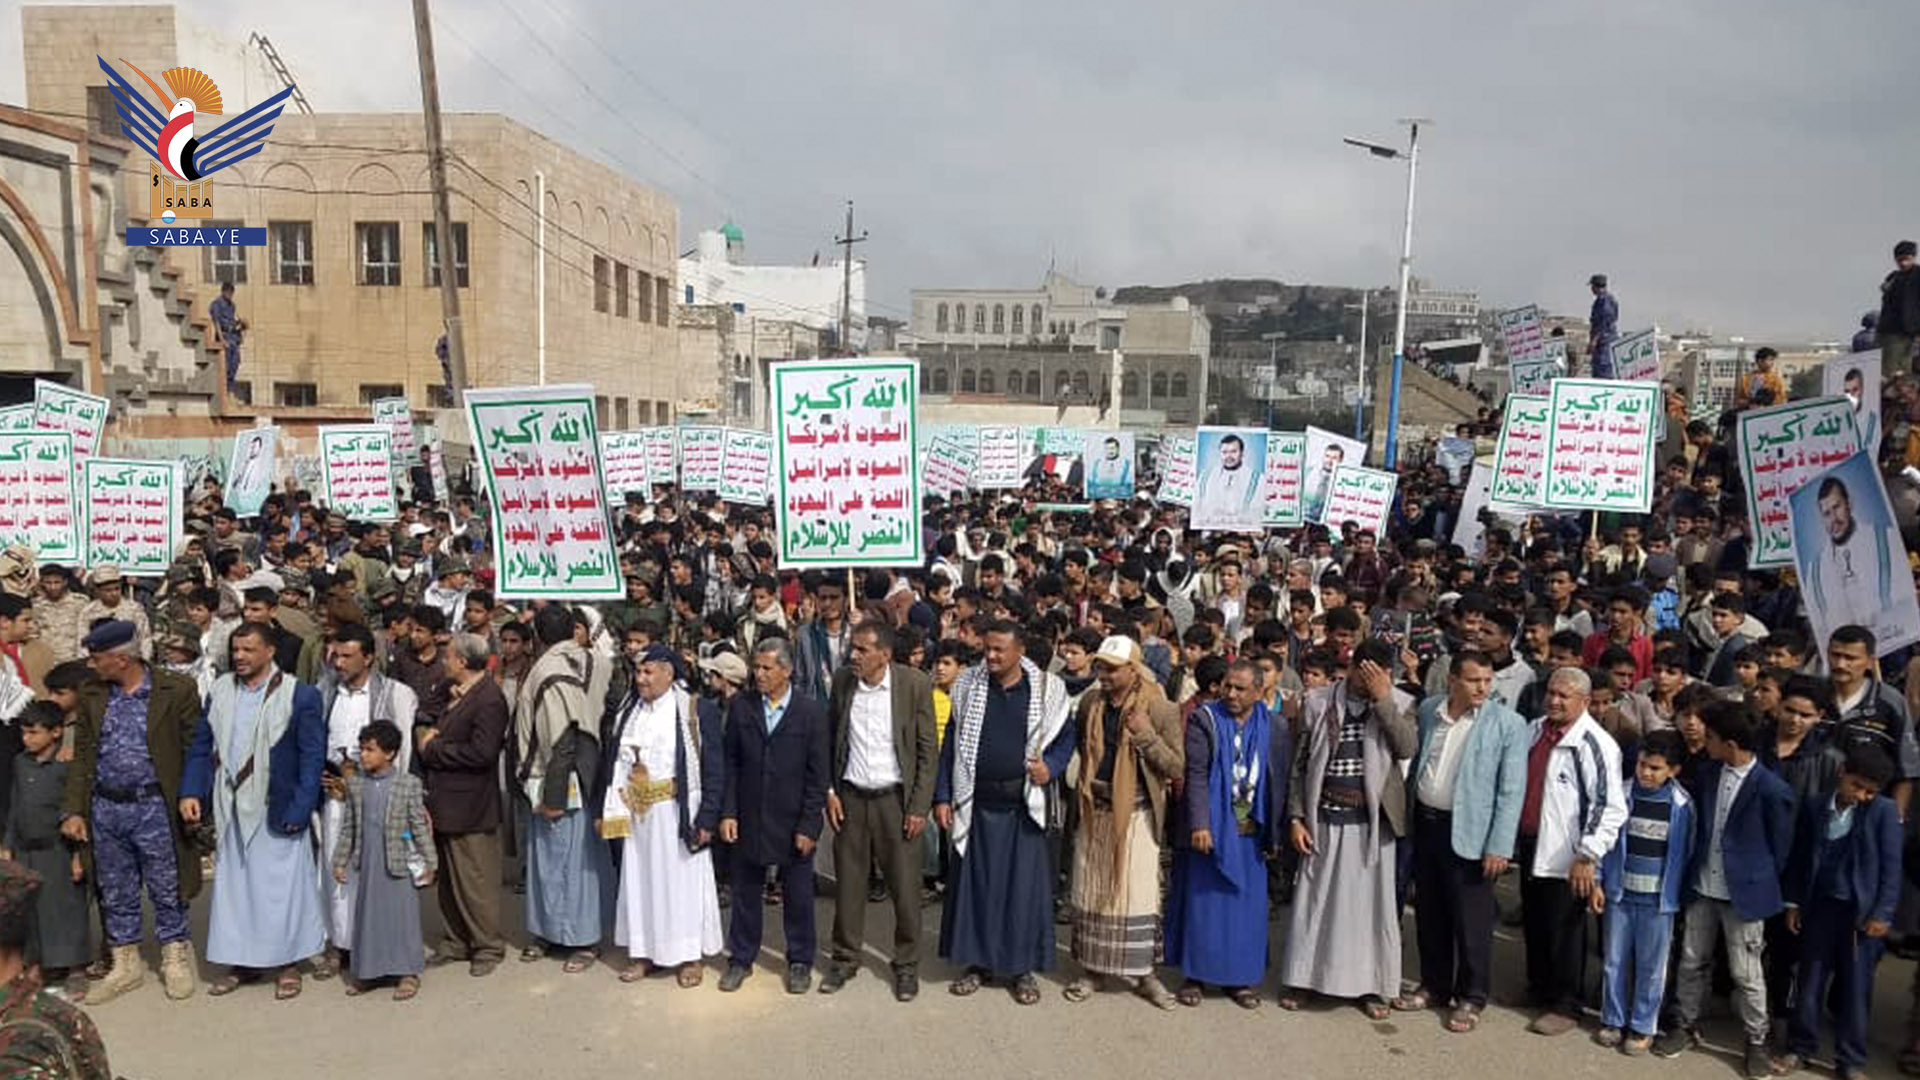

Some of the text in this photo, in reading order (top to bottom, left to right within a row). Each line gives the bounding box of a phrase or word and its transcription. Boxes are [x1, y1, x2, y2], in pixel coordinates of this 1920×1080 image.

[861, 376, 908, 409] الله
[1616, 394, 1650, 413] الله
[550, 411, 591, 442] الله
[1513, 407, 1549, 427] كبر
[1813, 410, 1853, 436] الله
[856, 421, 908, 447] الموت
[37, 441, 67, 460] الله
[140, 470, 169, 488] الله
[548, 454, 597, 481] الموت
[857, 455, 909, 481] الموت
[554, 487, 602, 514] الموت
[789, 486, 909, 517] اللعنة على اليهود
[504, 517, 607, 546] اللعنة على اليهود
[857, 516, 910, 553] النصر
[564, 548, 613, 584] النصر
